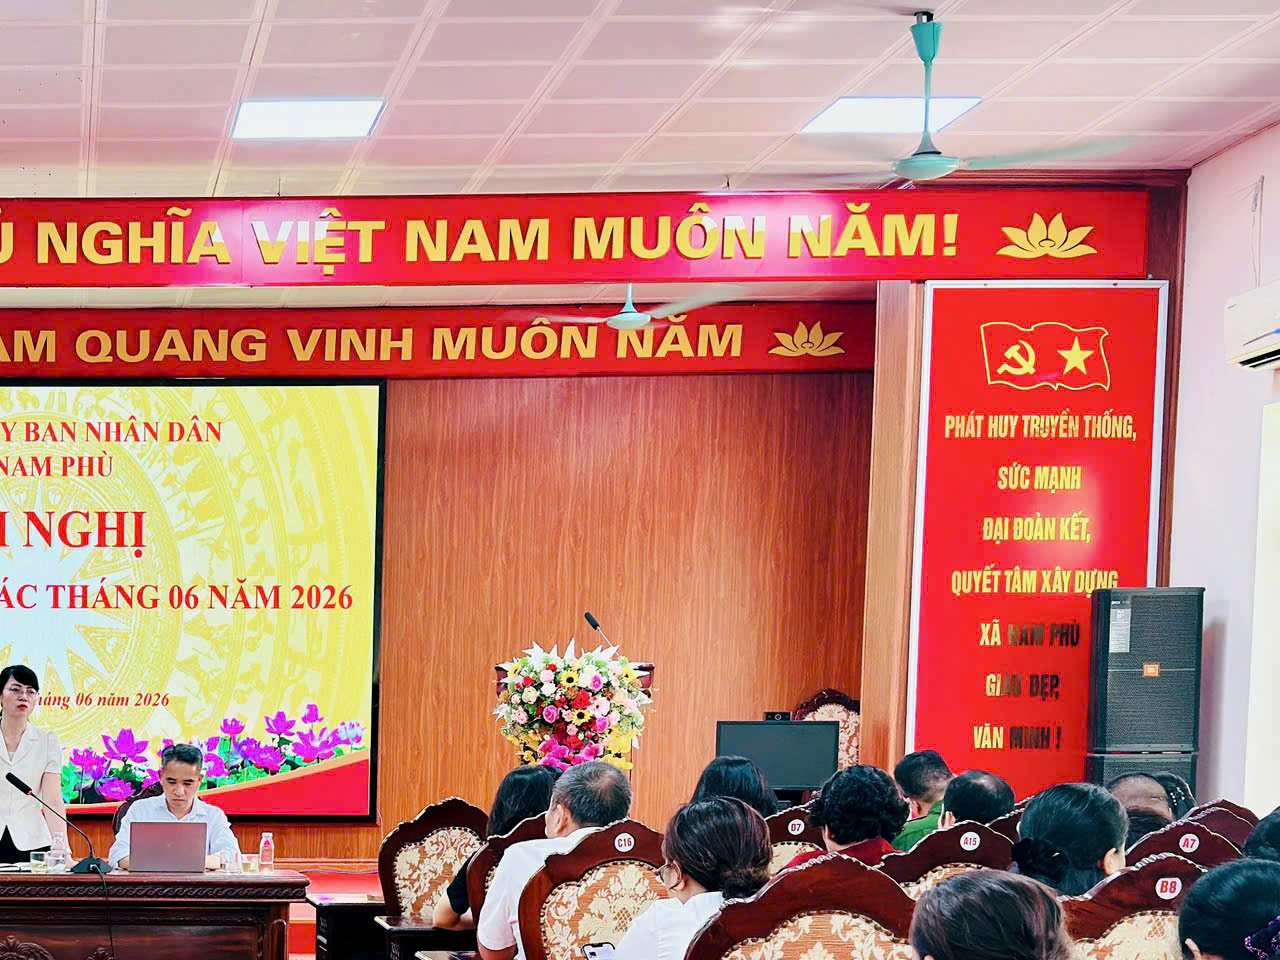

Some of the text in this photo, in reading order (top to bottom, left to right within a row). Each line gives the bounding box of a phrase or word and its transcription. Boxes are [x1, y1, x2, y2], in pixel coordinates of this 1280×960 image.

[37, 208, 229, 265] NGHĨA
[251, 210, 384, 275] VIỆT
[408, 218, 548, 263] NAM
[573, 204, 765, 260] MUÔN
[789, 204, 957, 259] NĂM!
[76, 330, 266, 364] QUANG
[287, 328, 412, 362] VINH
[432, 317, 597, 360] MUÔN
[616, 315, 743, 358] NĂM
[25, 422, 76, 443] BAN
[85, 416, 160, 443] NHÂN
[168, 416, 222, 443] DÂN
[945, 408, 1136, 441] PHÁT HUY TRUYỀN THỐNG,
[62, 452, 113, 477] PHÙ
[998, 462, 1081, 494] SỨC MẠNH
[23, 510, 146, 557] NGHỊ
[983, 511, 1091, 545] ĐẠI ĐOÀN KẾT,
[49, 575, 159, 610] THÁNG
[168, 582, 198, 610] 06
[209, 576, 280, 610] NĂM
[291, 582, 353, 610] 2026
[952, 564, 1118, 598] QUYẾT TÂM XÂY DỰNG
[980, 619, 1001, 646] XÃ
[1008, 624, 1045, 646] NAM
[39, 692, 71, 710] áng
[75, 692, 92, 706] 06
[97, 692, 129, 706] năm
[134, 692, 170, 707] 2026
[974, 723, 1004, 749] VĂN
[1009, 727, 1051, 749] MINH
[617, 838, 632, 848] C16
[963, 837, 977, 846] A15
[1182, 838, 1196, 848] A7
[1160, 880, 1177, 893] B8
